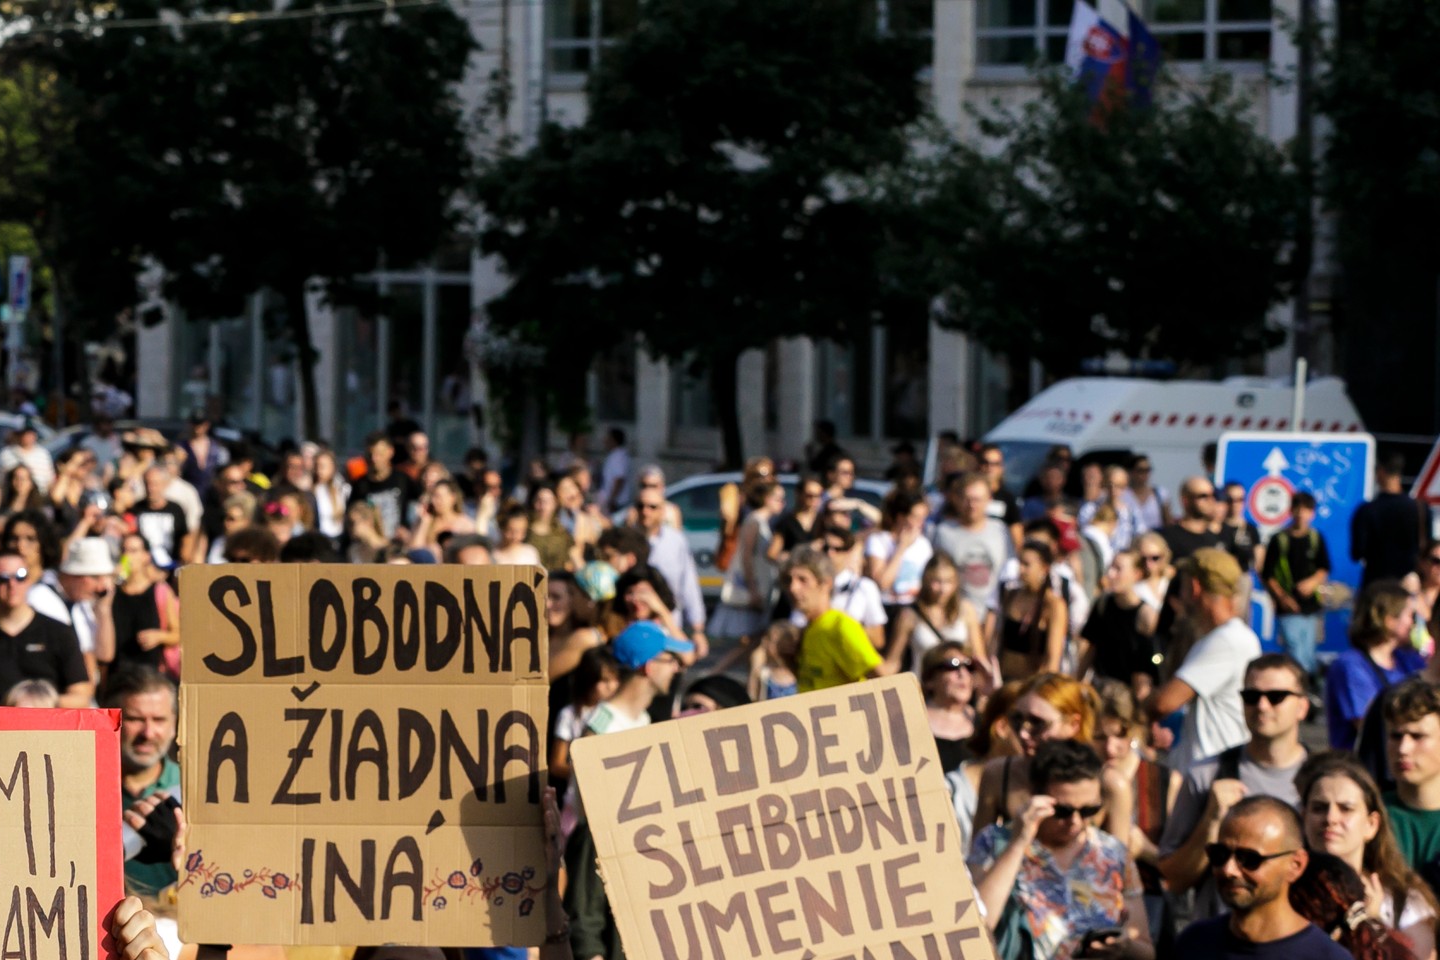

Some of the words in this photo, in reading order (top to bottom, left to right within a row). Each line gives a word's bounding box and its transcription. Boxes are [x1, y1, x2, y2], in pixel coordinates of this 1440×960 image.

[203, 572, 545, 678] SLOBODNÁ
[205, 711, 249, 804] A
[271, 681, 541, 806] ŽIADNA
[300, 810, 446, 925] INÁ
